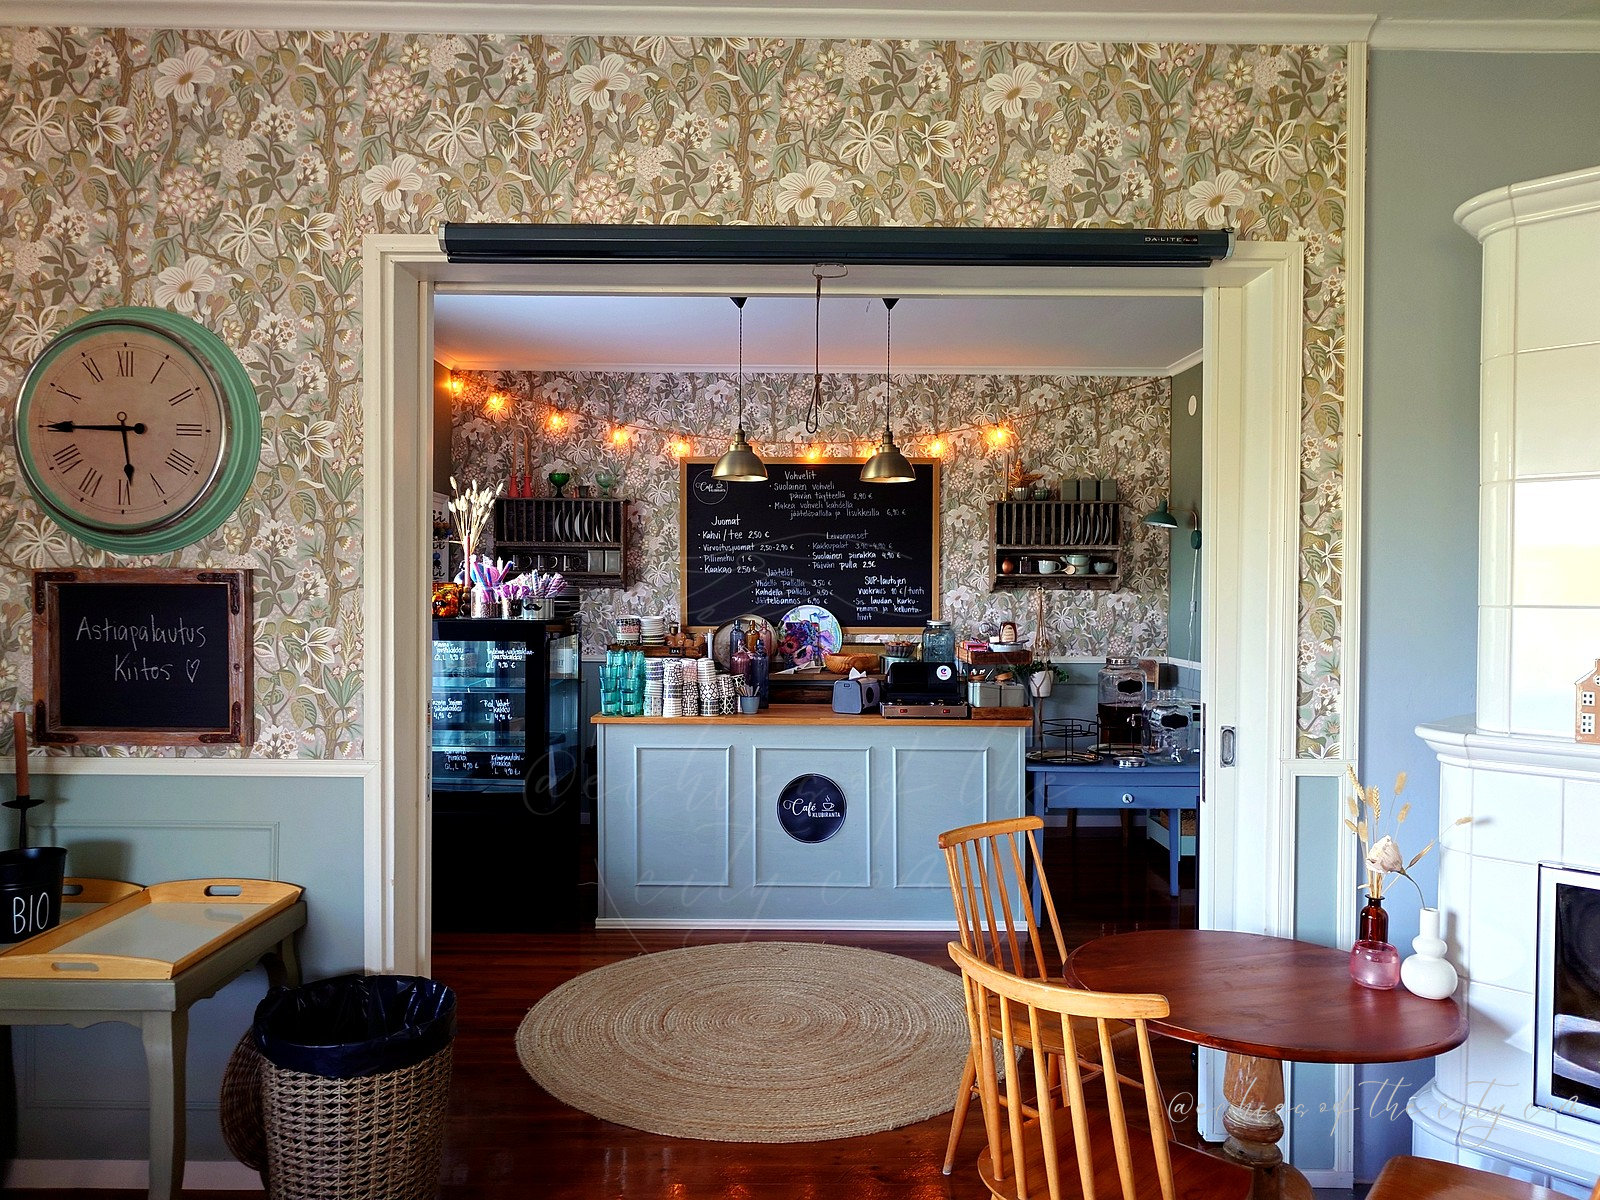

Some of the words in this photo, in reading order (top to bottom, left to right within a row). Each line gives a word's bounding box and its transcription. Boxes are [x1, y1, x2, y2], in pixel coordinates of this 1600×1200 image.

[116, 350, 134, 378] XII
[168, 388, 194, 407] II
[176, 423, 203, 437] III
[784, 470, 816, 480] Vohvelit
[773, 482, 807, 491] Suolainen
[812, 481, 835, 491] vohveli
[711, 513, 741, 526] Juomat
[702, 530, 721, 539] Kahvi
[728, 529, 743, 540] tee
[764, 530, 770, 539] €
[76, 614, 207, 652] Astiapalautus
[114, 652, 174, 682] Kiitos
[782, 798, 817, 818] Café
[12, 891, 50, 934] BIO
